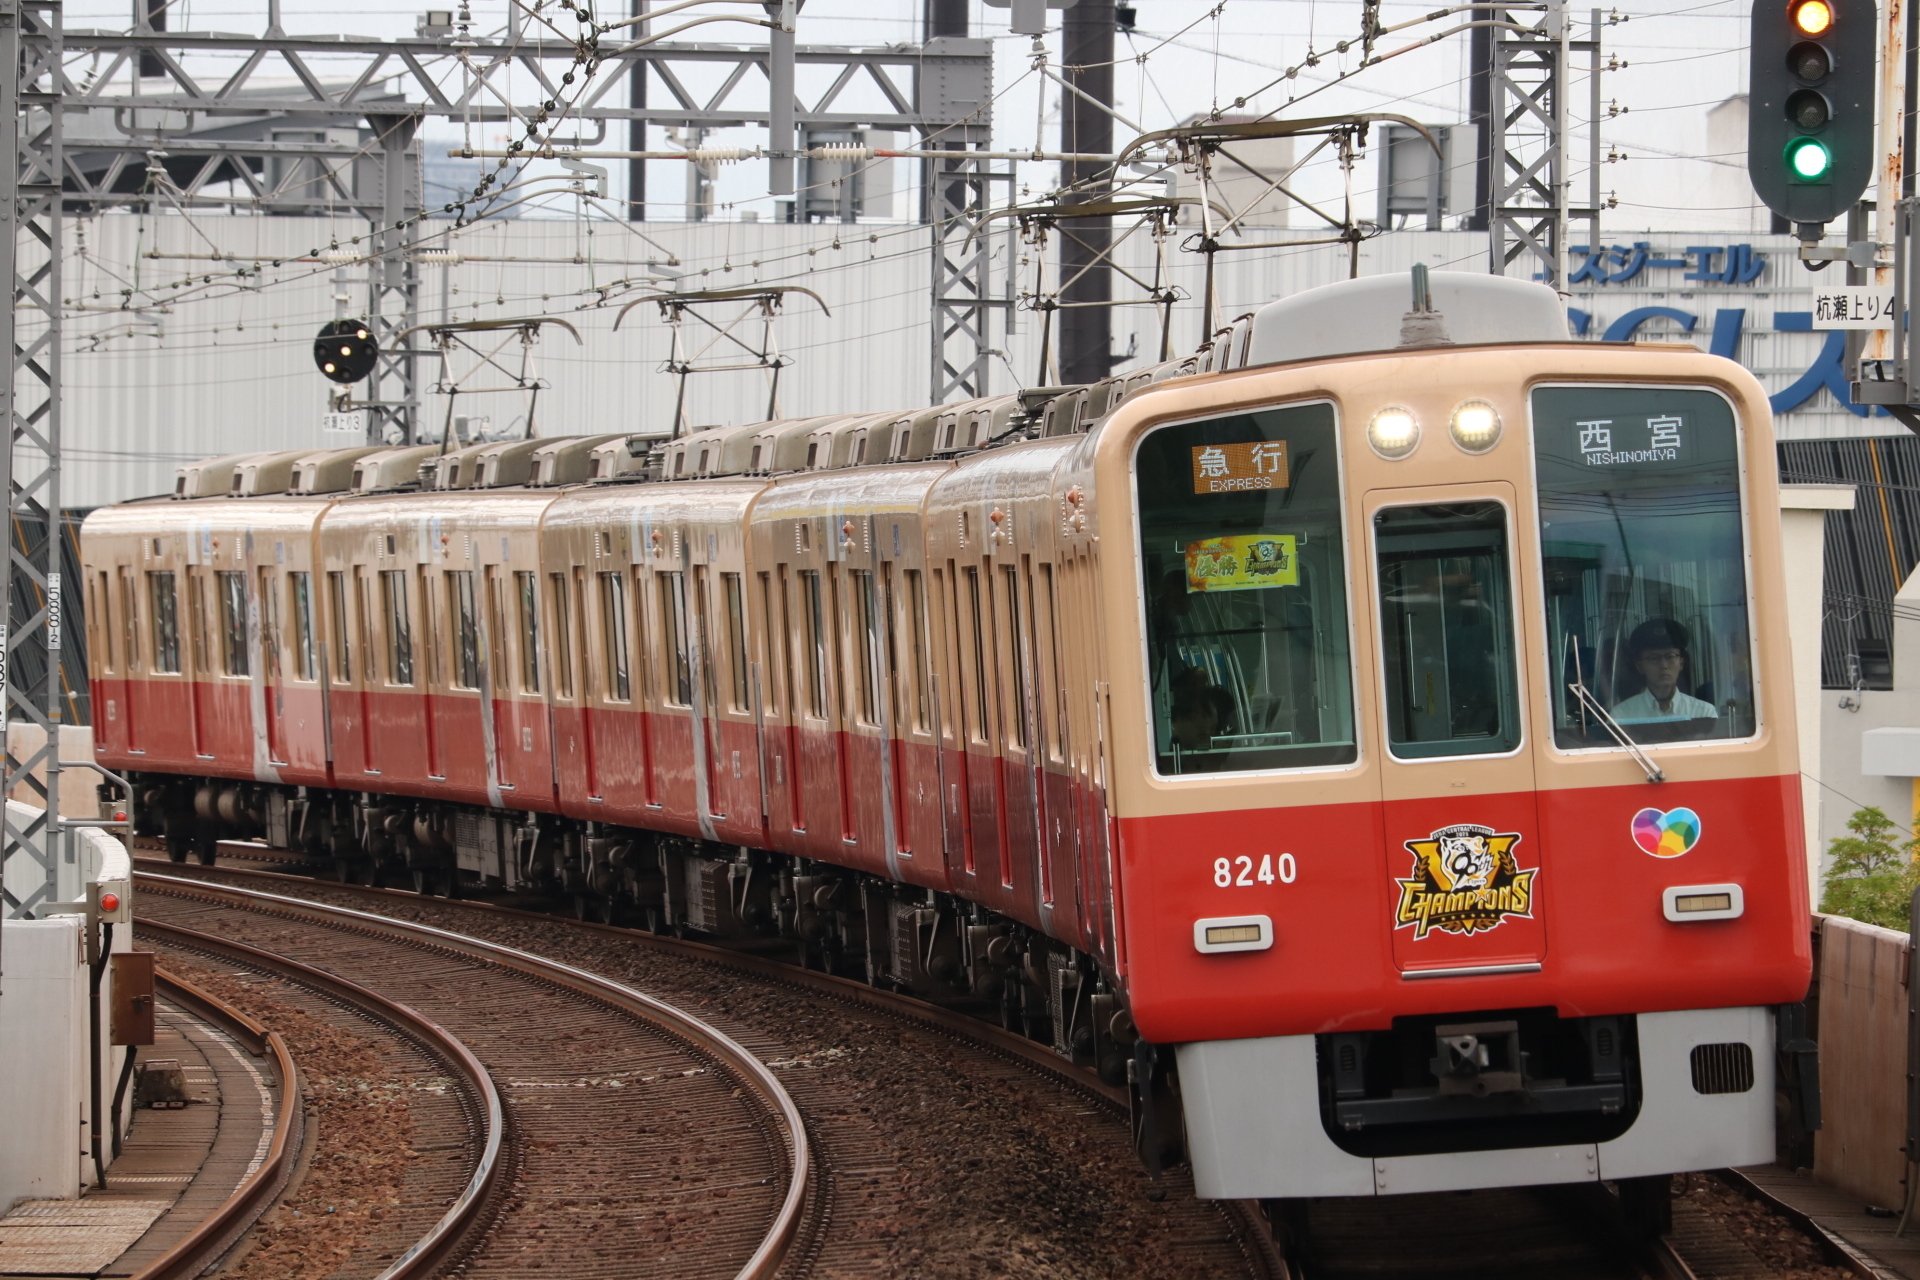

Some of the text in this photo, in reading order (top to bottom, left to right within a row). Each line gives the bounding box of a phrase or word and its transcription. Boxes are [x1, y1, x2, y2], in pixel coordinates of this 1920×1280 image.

[1816, 294, 1895, 321] 杭瀬上り4
[1576, 415, 1682, 454] 西宮
[1198, 443, 1281, 477] 急行
[1586, 449, 1676, 466] NISHINOMIYA
[1210, 477, 1272, 492] EXPRESS
[1446, 826, 1470, 835] CENTRAL
[1471, 826, 1492, 836] LEAGUE
[1214, 853, 1296, 888] 8240
[1400, 873, 1531, 935] CHAMPIONS
